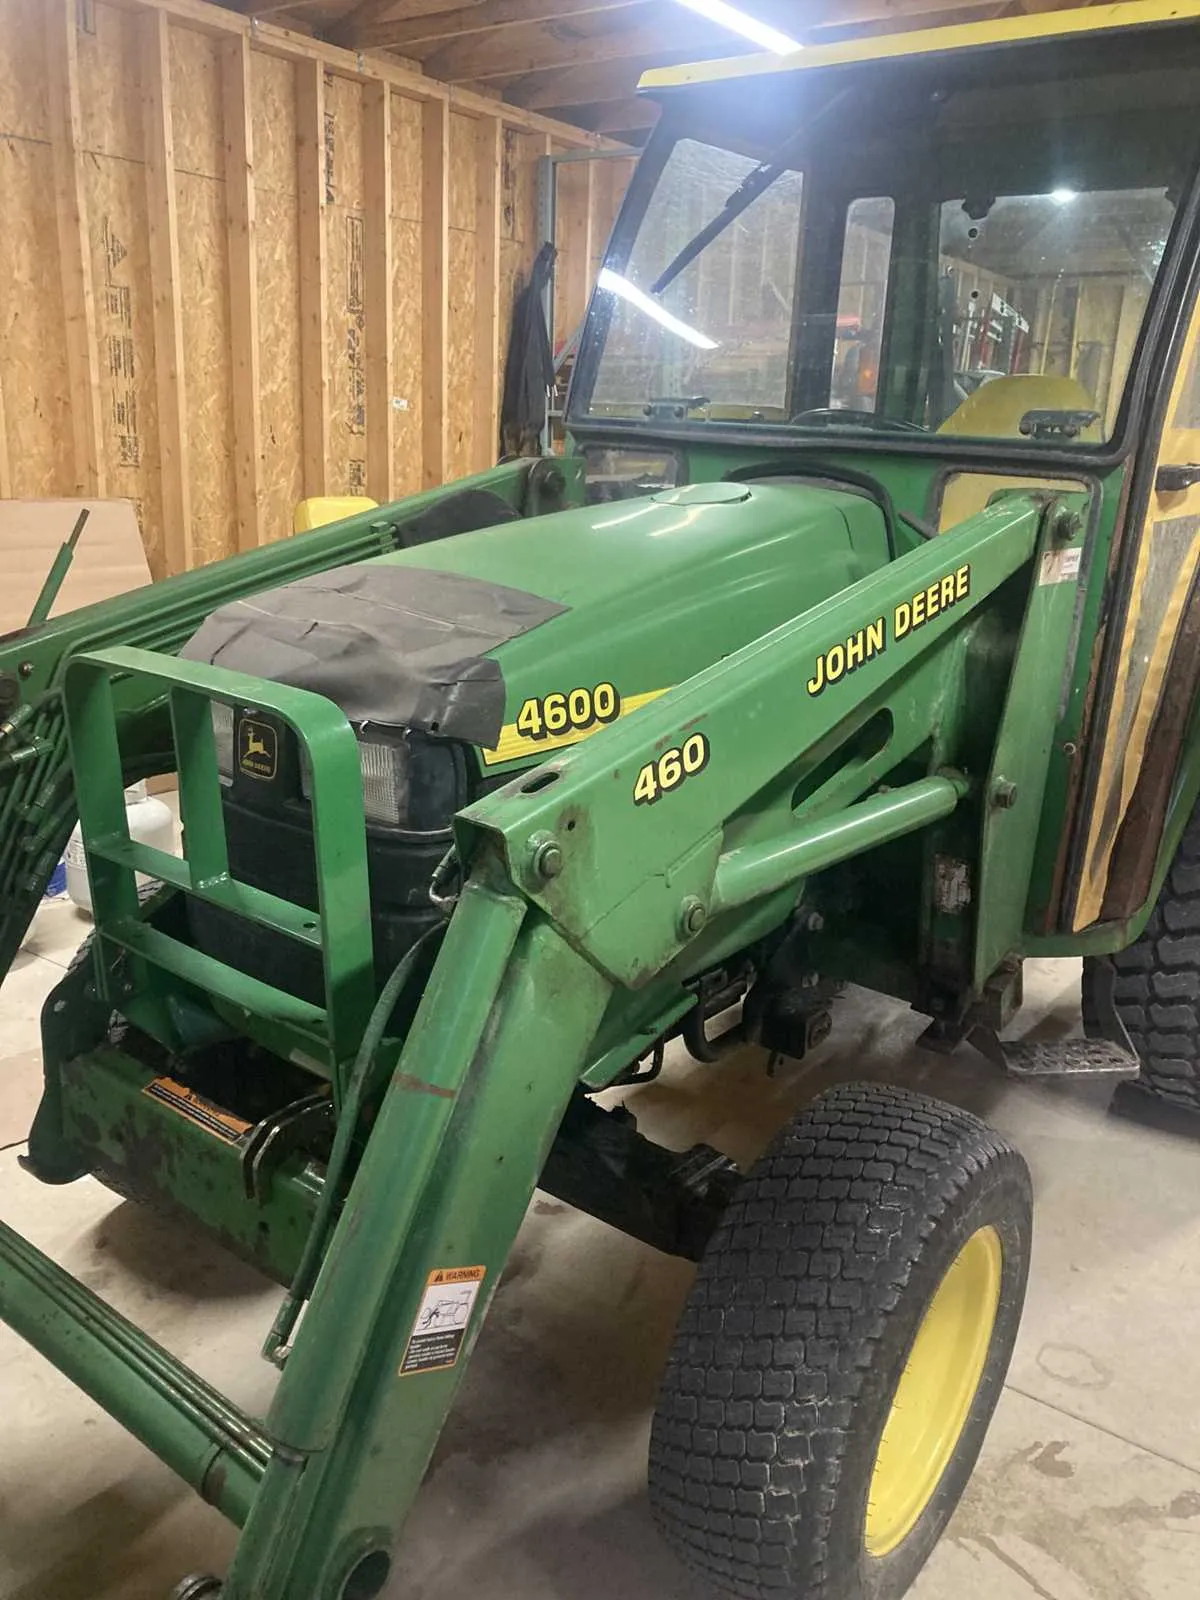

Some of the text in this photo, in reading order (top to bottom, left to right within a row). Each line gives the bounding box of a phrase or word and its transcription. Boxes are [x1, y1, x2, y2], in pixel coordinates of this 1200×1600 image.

[807, 564, 970, 696] JOHN DEERE
[517, 682, 620, 740] 4600
[634, 733, 710, 805] 460
[446, 1269, 480, 1281] WARNING
